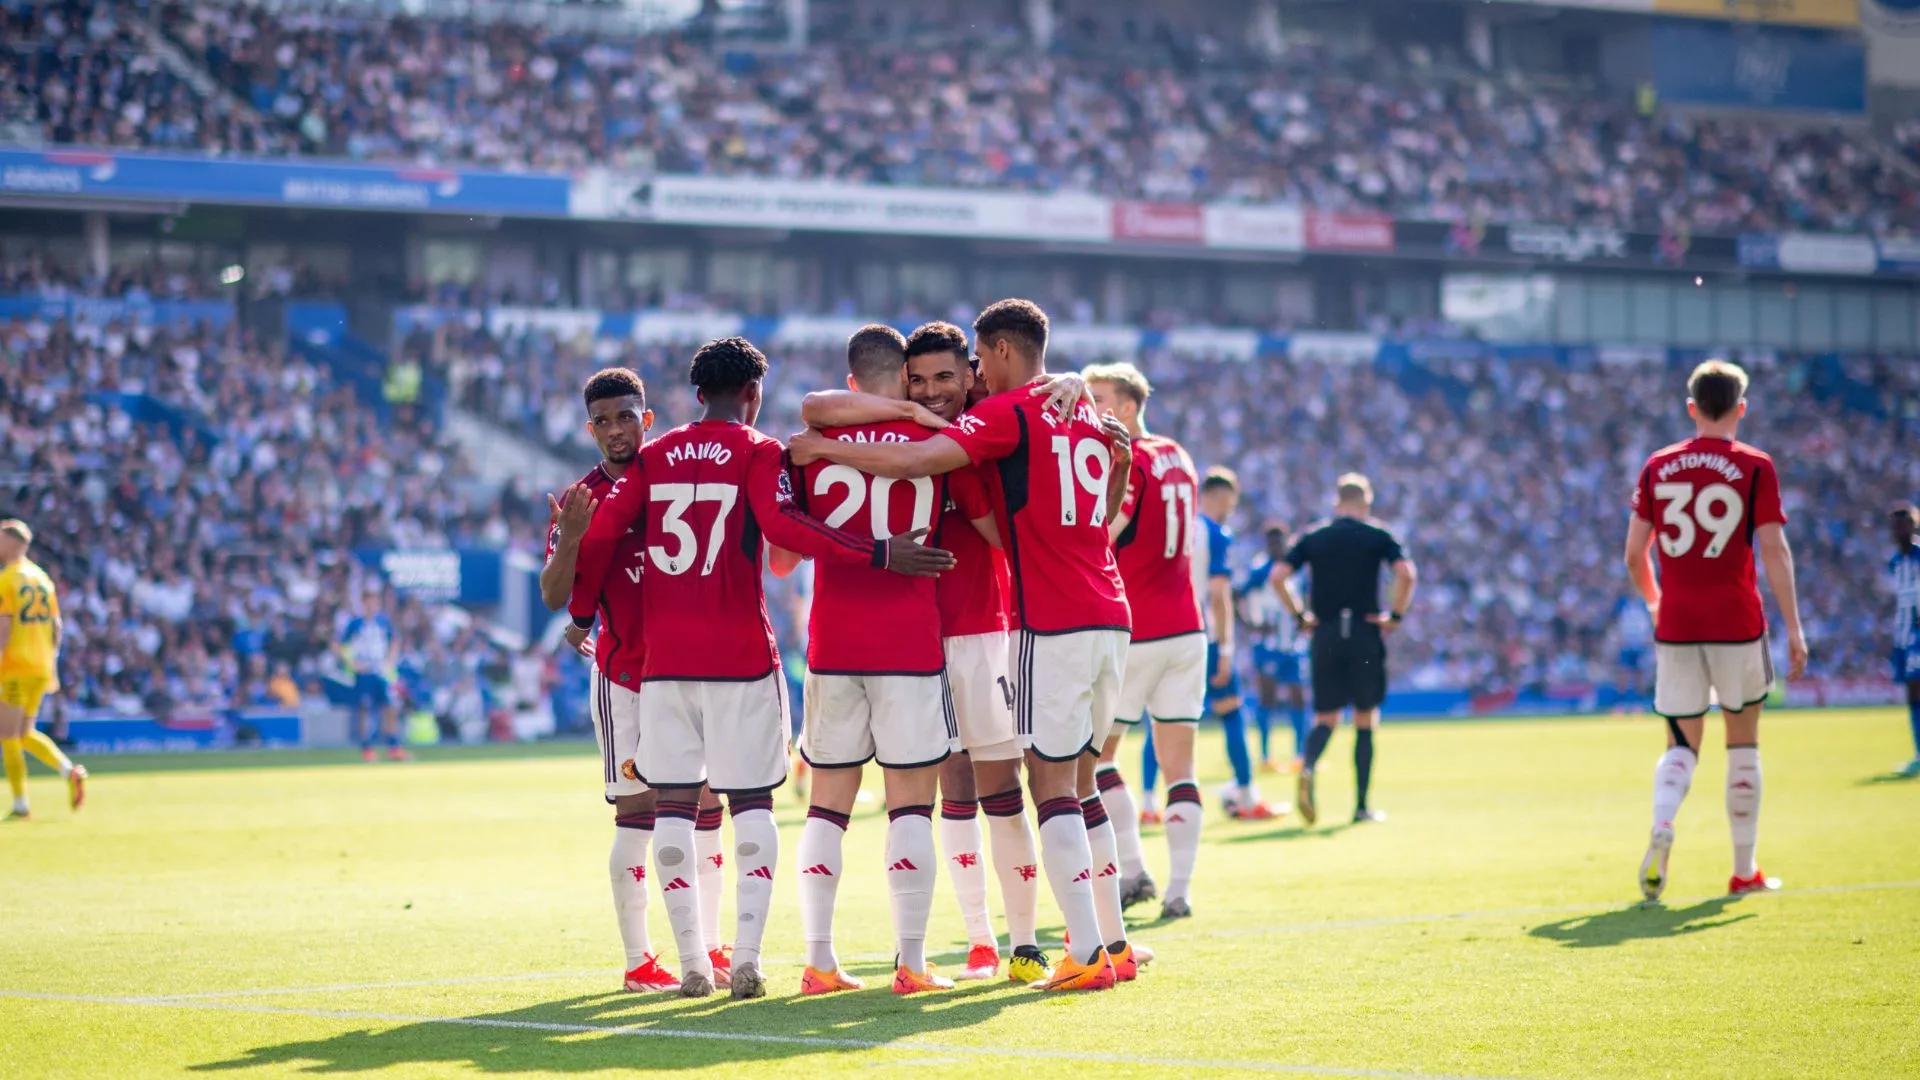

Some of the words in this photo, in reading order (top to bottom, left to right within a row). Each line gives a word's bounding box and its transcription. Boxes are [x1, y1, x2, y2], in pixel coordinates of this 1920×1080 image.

[814, 464, 934, 545] 20
[1051, 435, 1110, 527] 19
[1654, 482, 1744, 558] 39
[647, 483, 738, 576] 37
[1161, 483, 1193, 558] 11
[19, 584, 50, 624] 23
